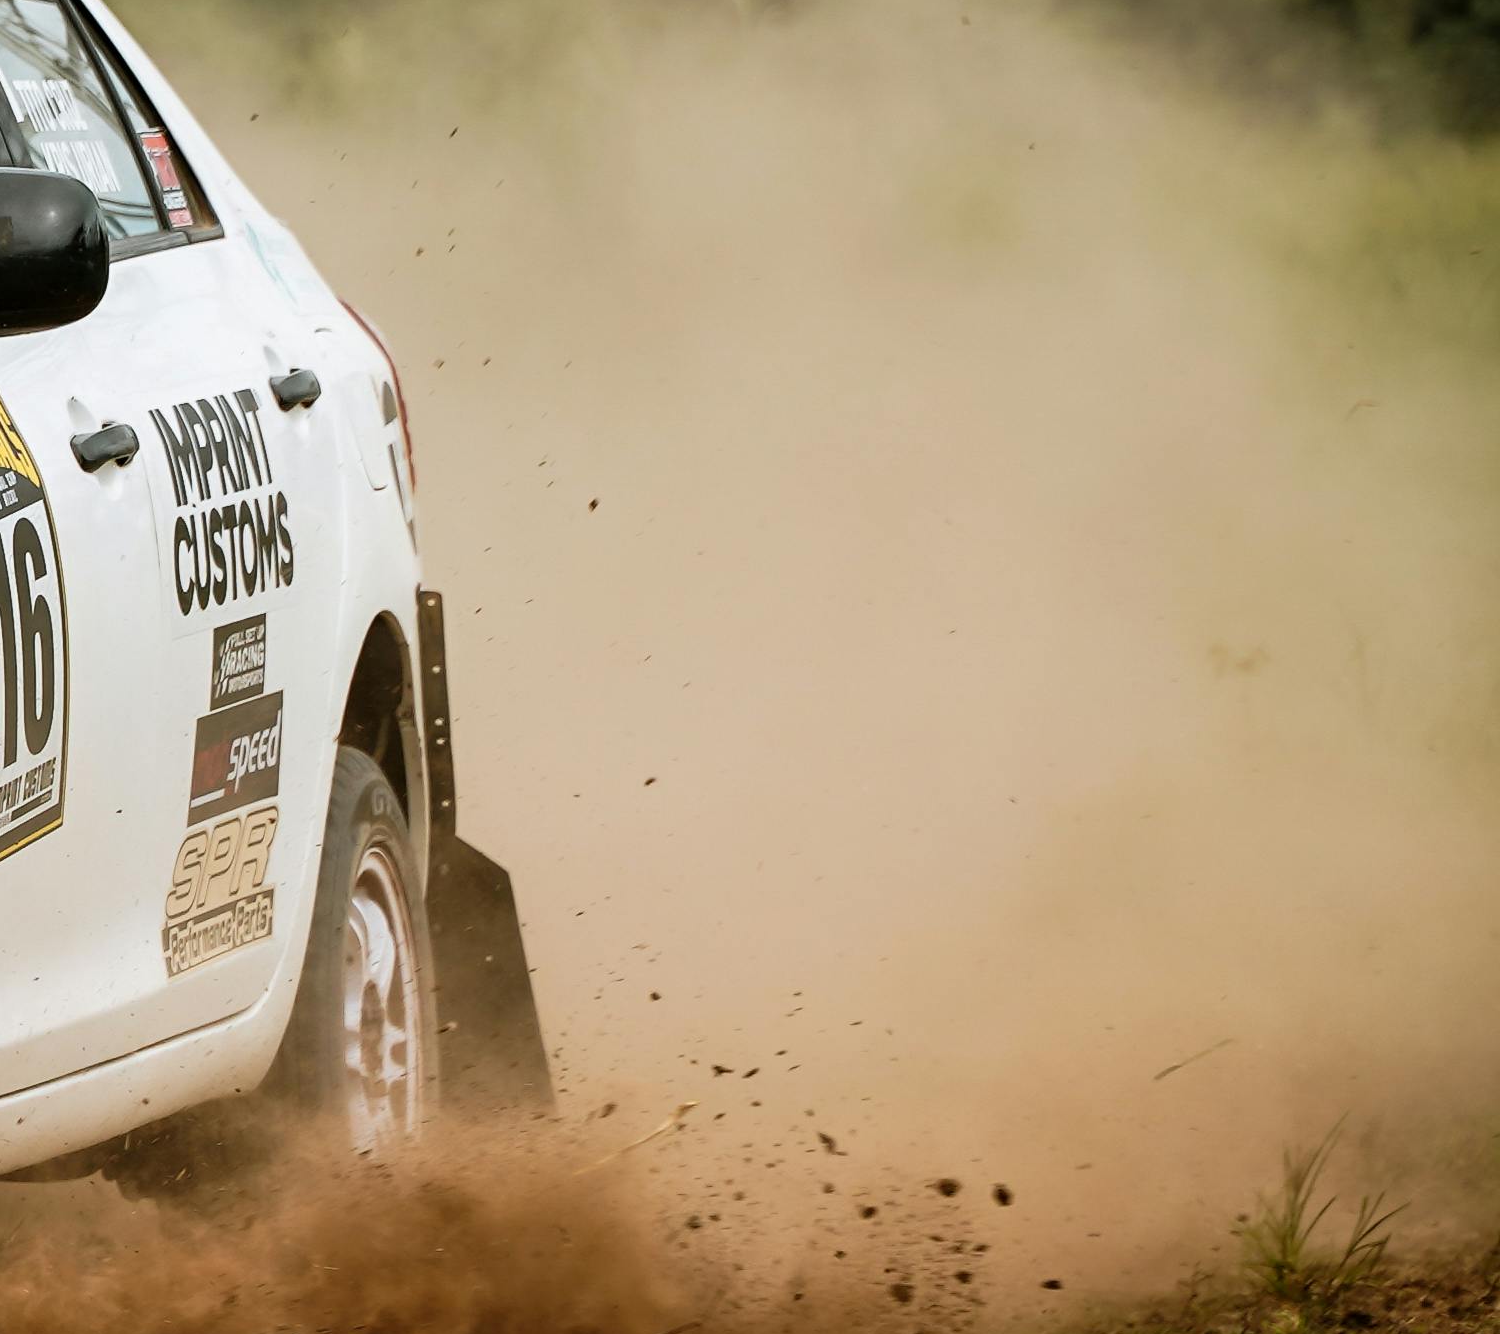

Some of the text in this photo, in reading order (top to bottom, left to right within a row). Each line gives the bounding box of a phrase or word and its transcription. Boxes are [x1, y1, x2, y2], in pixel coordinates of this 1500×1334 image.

[148, 387, 273, 508] IMPRINT
[173, 490, 294, 617] CUSTOMS
[226, 642, 265, 678] RACING
[165, 805, 279, 920] SPR
[234, 895, 272, 948] Parts
